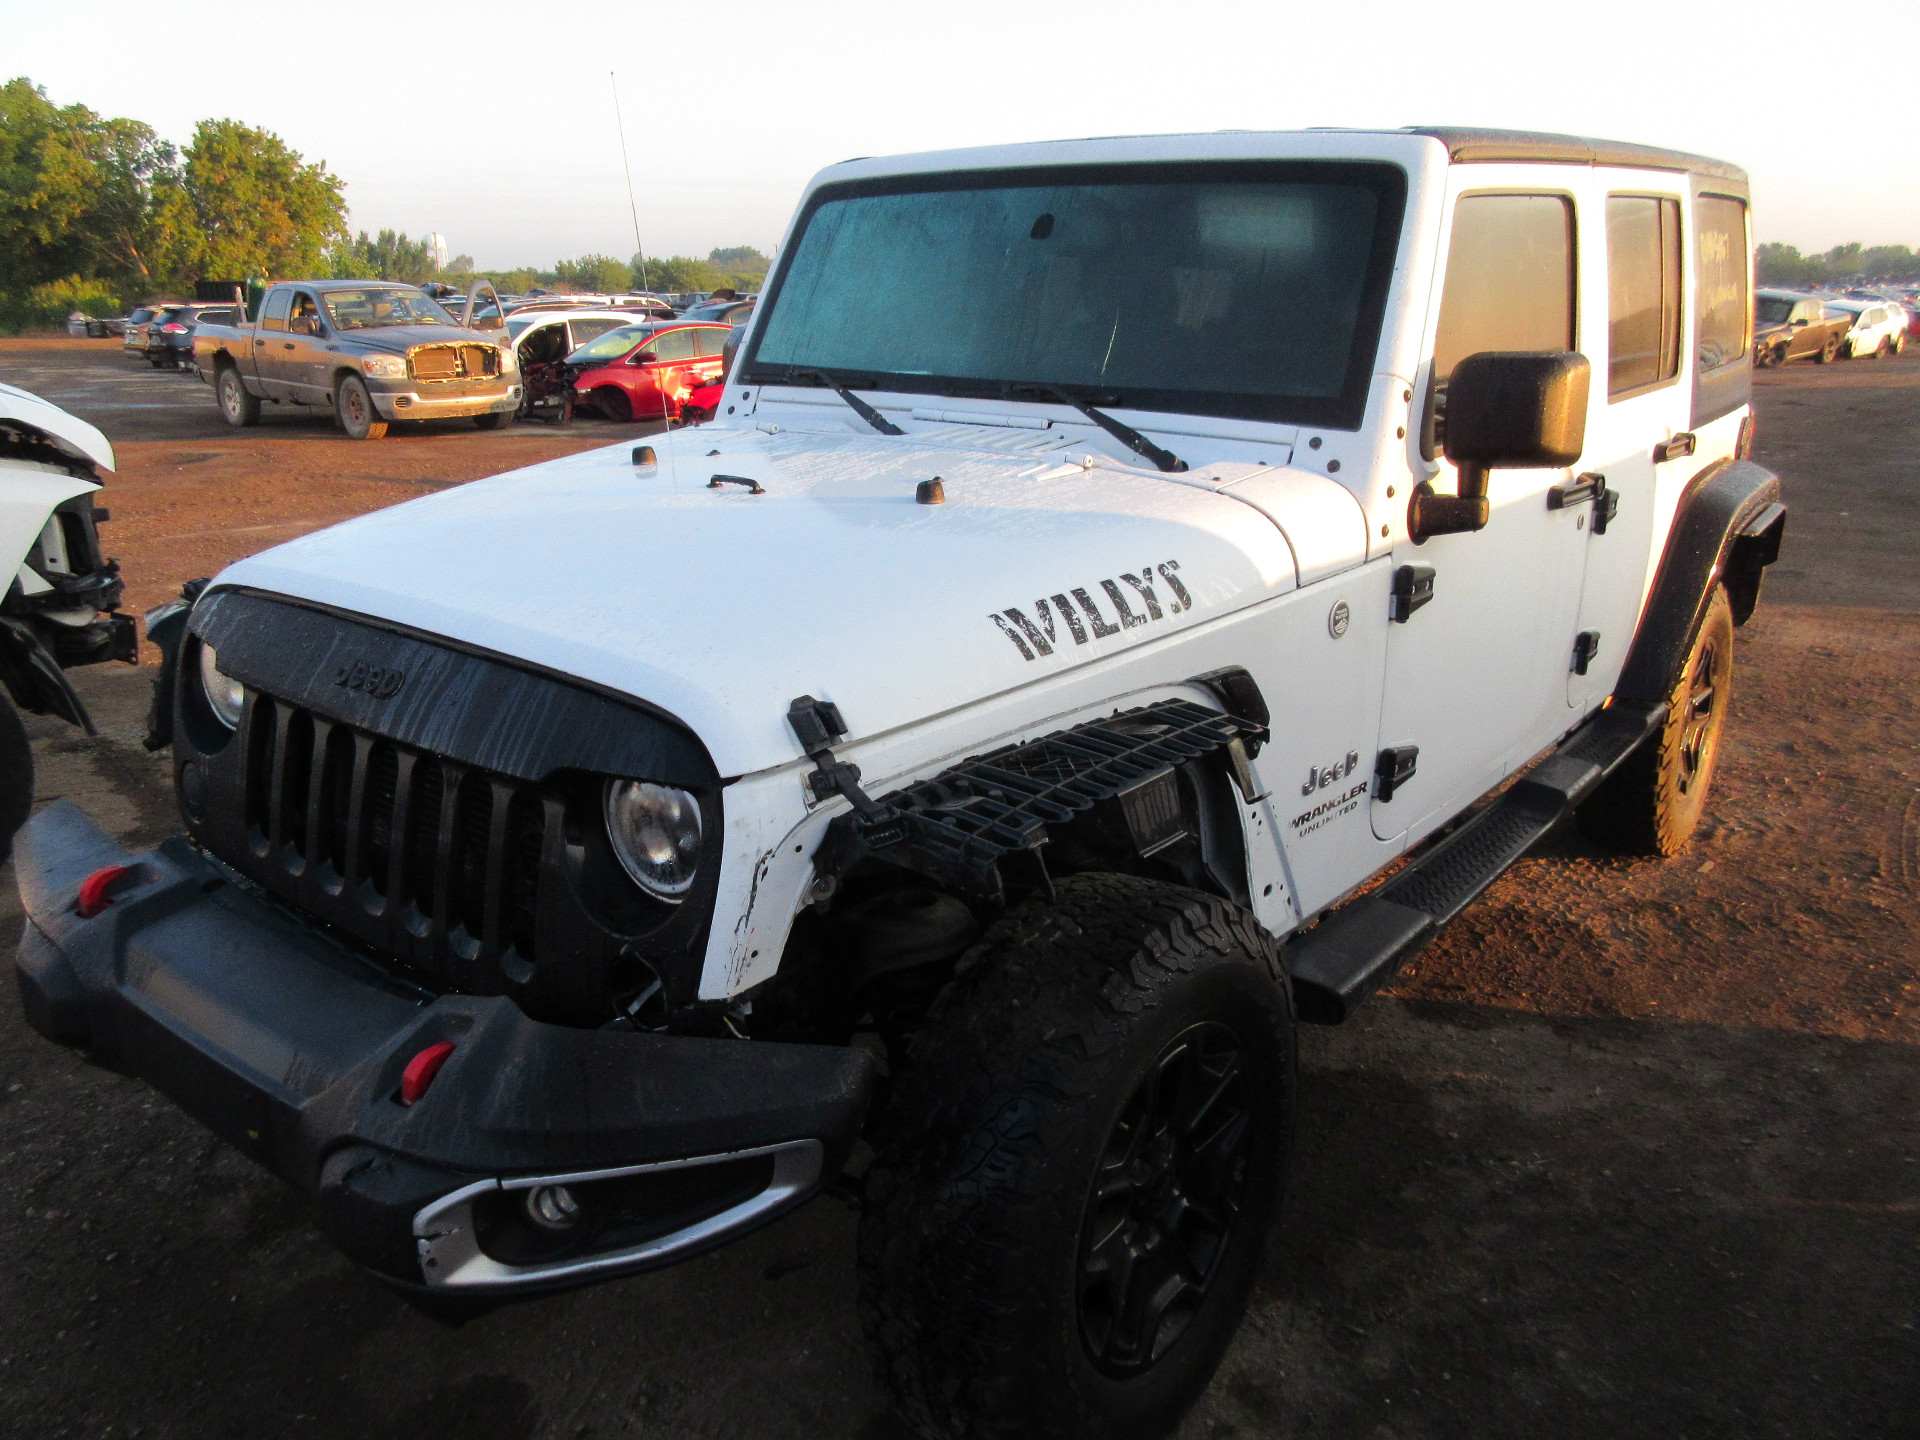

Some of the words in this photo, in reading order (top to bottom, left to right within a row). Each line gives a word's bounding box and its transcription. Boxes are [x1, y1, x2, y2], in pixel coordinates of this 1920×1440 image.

[988, 559, 1192, 662] WILLYS
[1302, 750, 1359, 797] Jeep
[1288, 781, 1368, 829] WRANGLER
[1299, 801, 1358, 838] UNLIMITED
